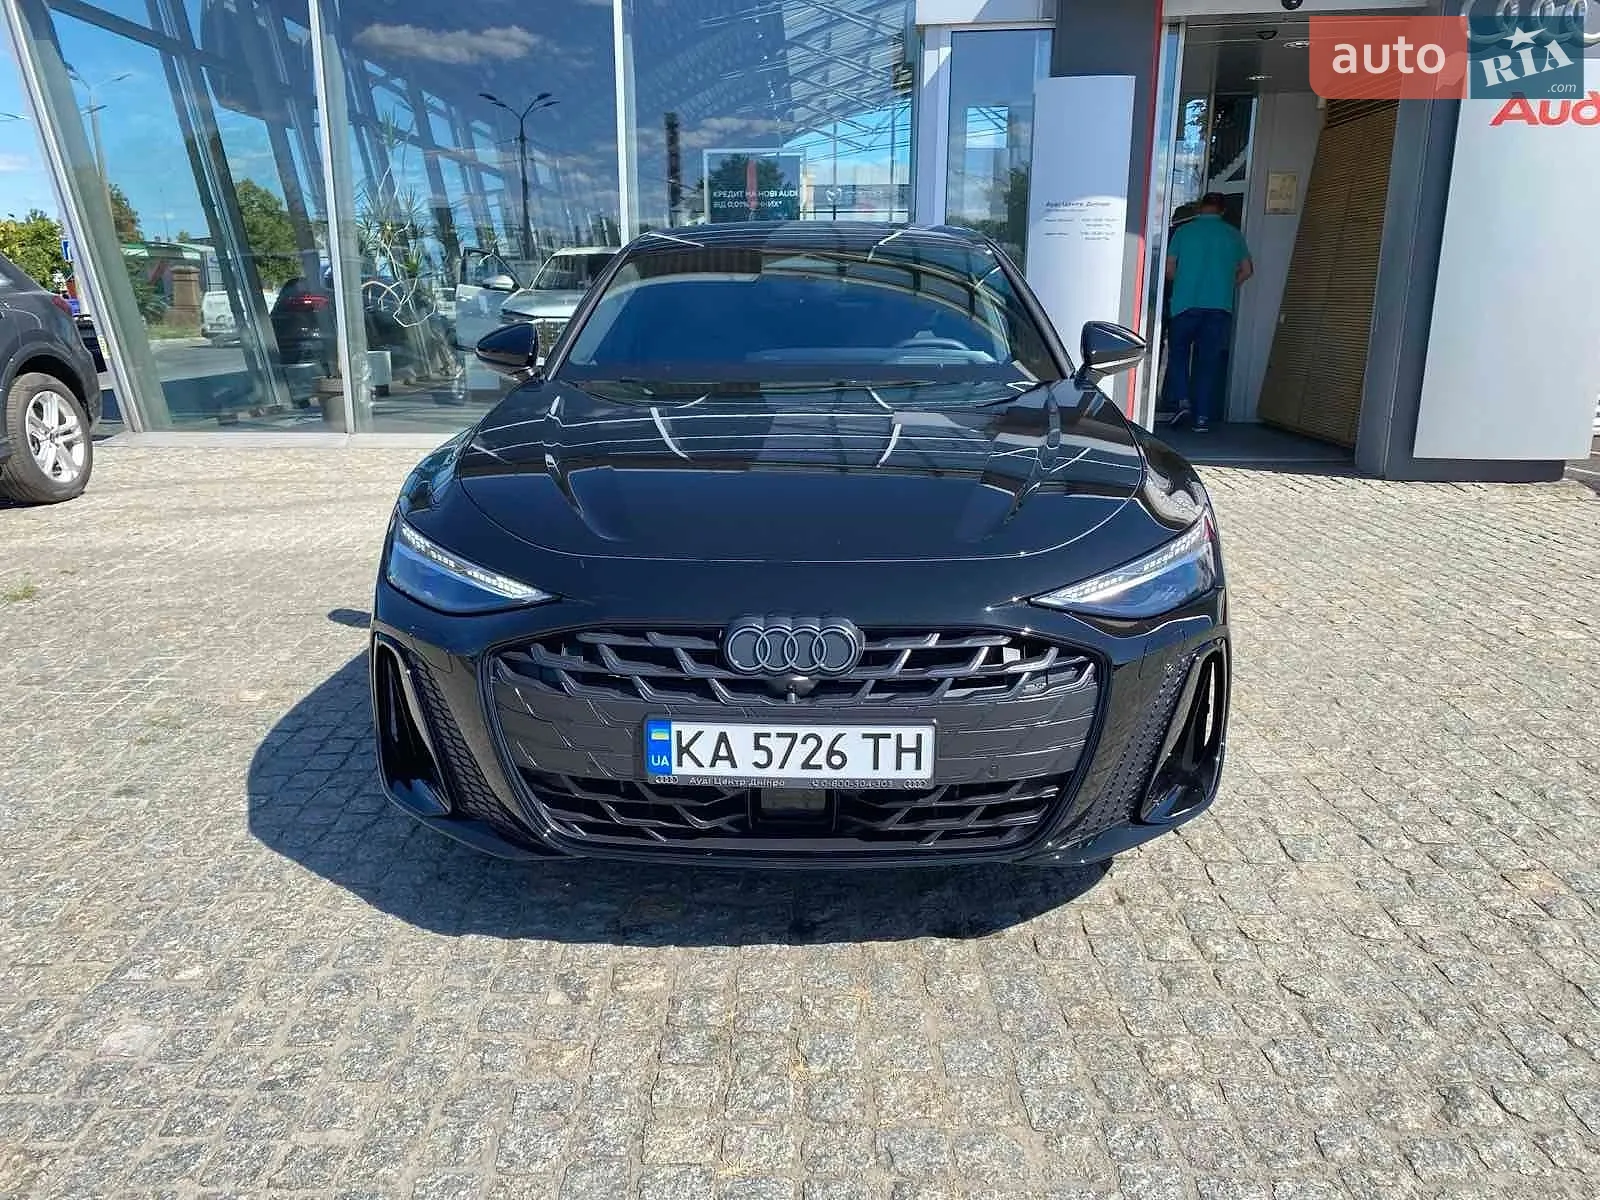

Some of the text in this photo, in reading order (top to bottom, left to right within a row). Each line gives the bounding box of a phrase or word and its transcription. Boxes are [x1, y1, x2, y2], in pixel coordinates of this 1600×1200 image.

[651, 730, 923, 771] UA KA 5726 TH
